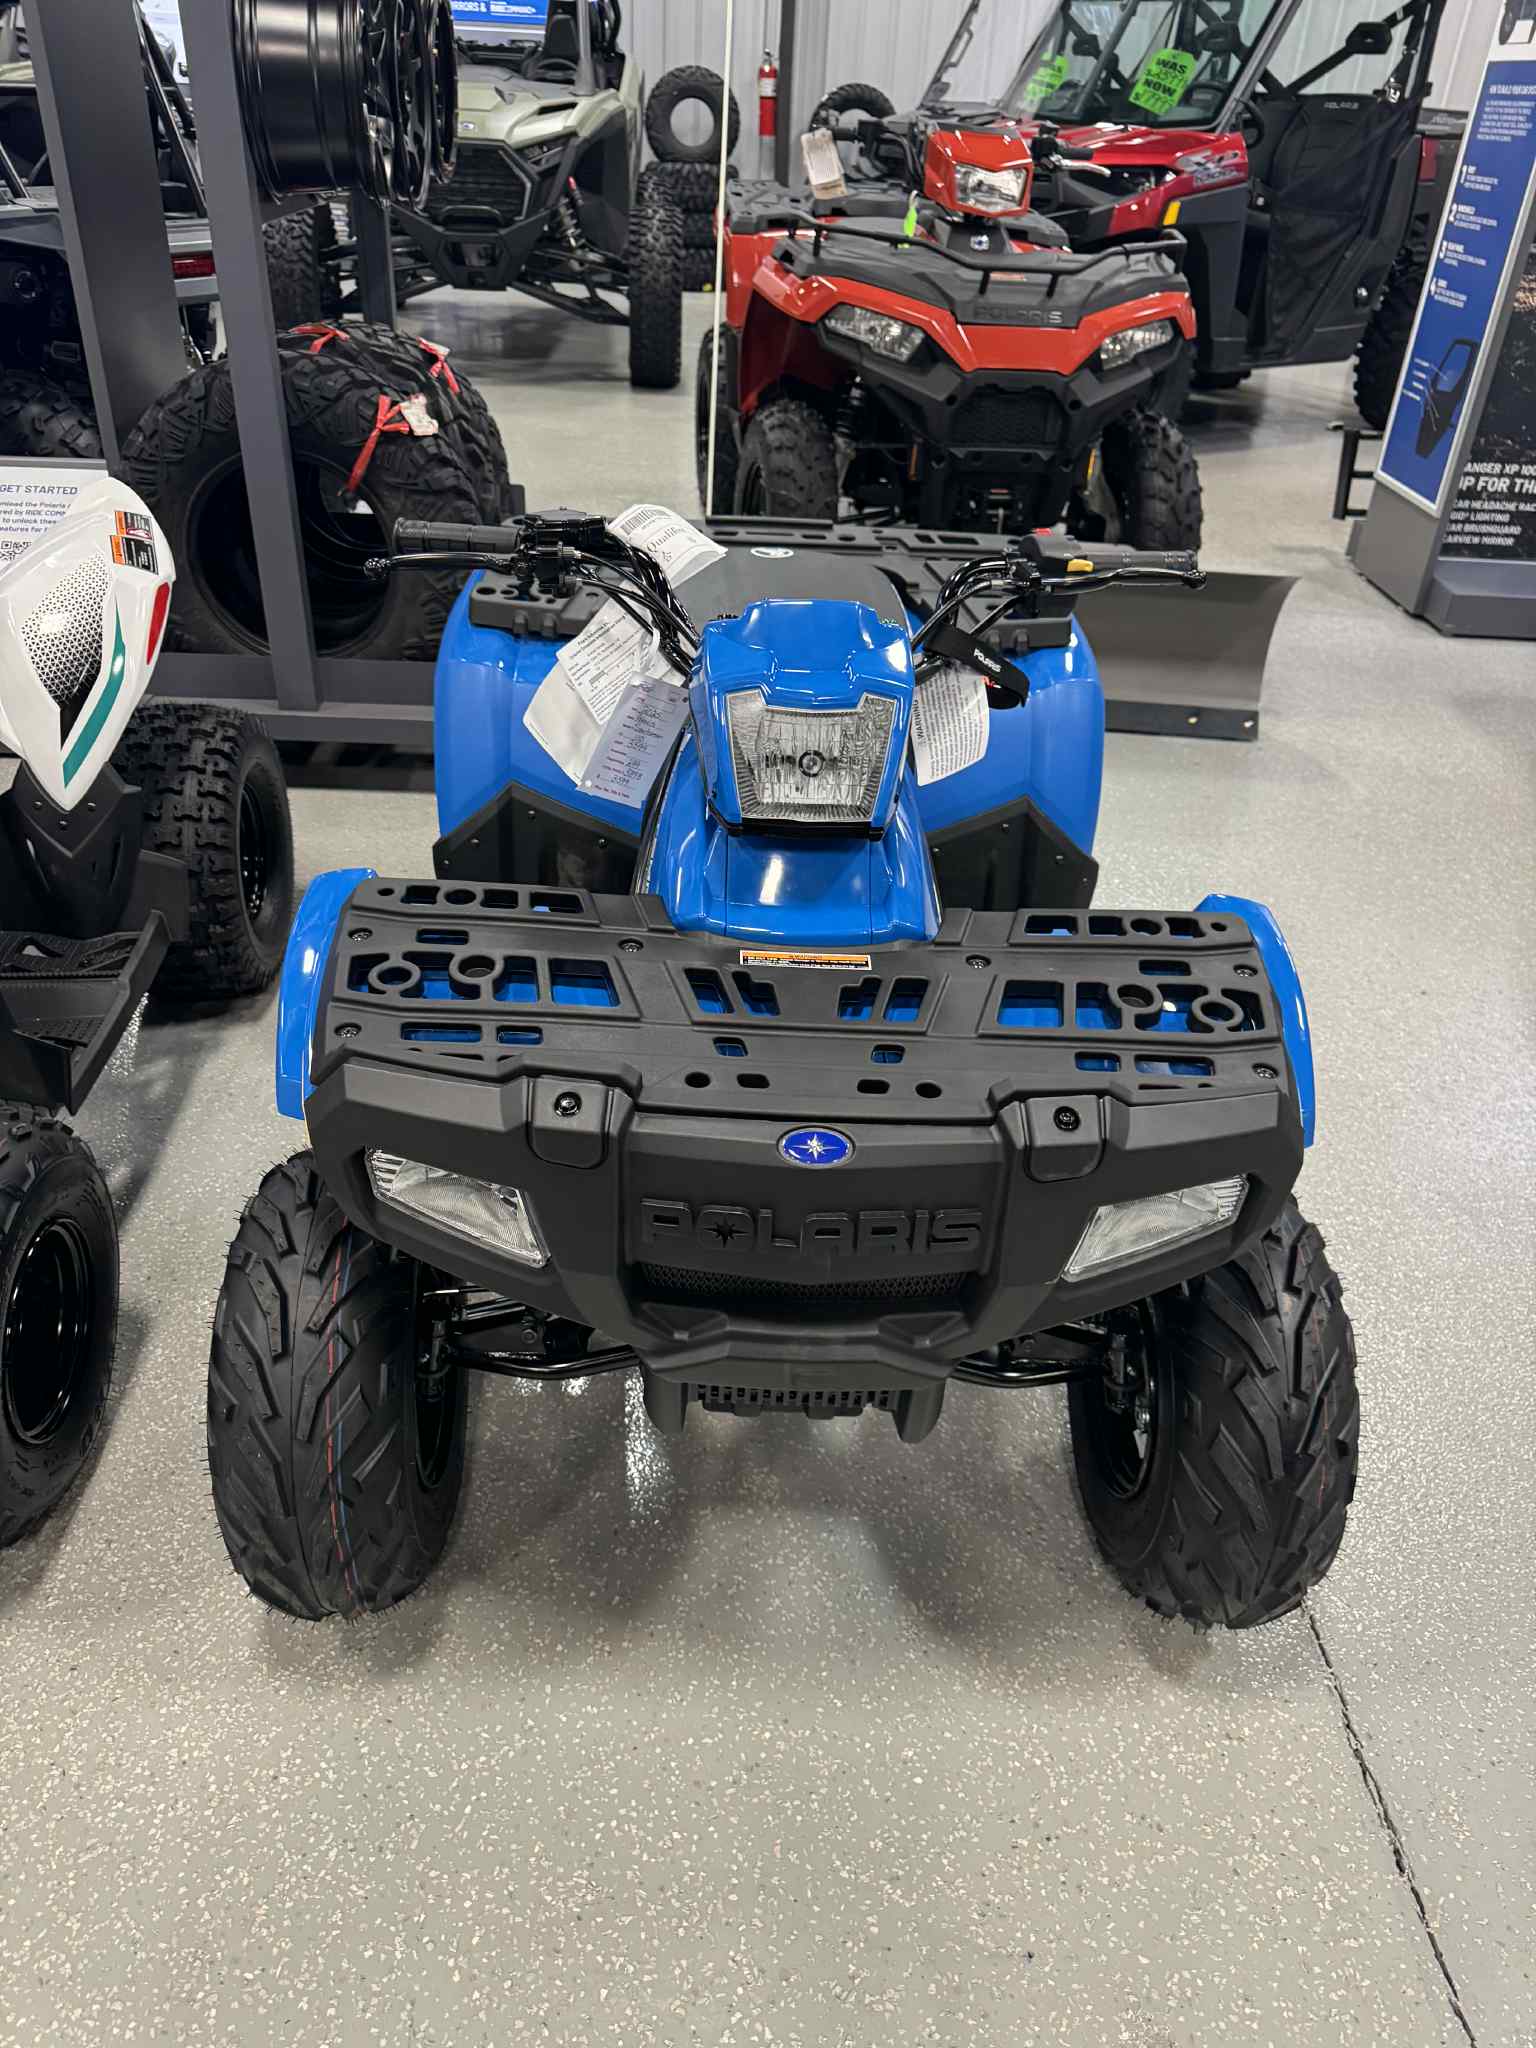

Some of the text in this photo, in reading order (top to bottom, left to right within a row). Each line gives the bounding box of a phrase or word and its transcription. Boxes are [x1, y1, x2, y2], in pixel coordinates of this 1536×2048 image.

[1156, 58, 1188, 74] WAS
[1143, 78, 1177, 97] NOW
[1503, 463, 1520, 475] XP
[0, 484, 79, 495] GET STARTED
[1477, 475, 1511, 493] FOR
[974, 649, 1001, 672] POLARIS
[641, 1198, 983, 1255] POLARIS
